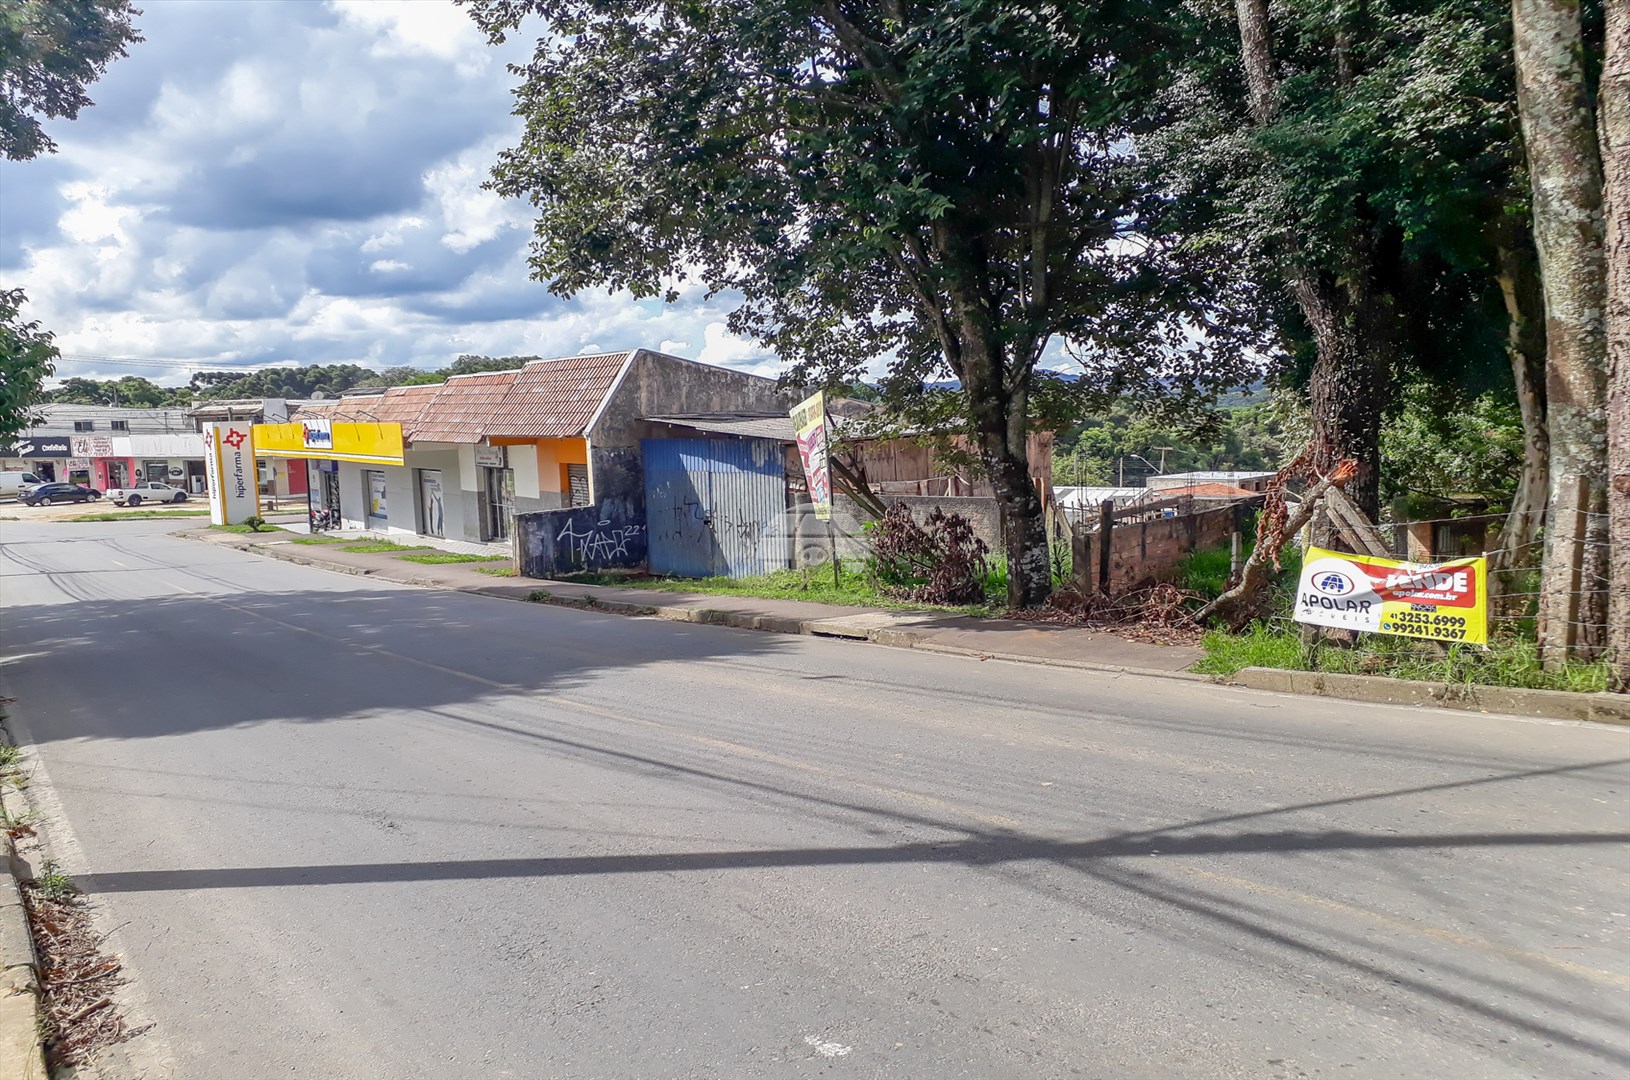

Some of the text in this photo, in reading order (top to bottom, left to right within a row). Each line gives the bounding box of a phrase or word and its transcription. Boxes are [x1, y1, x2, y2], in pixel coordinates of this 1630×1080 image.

[233, 451, 247, 498] hiperfarma
[1301, 592, 1371, 614] APOLAR
[1393, 589, 1458, 601] apolar.com.br
[1399, 612, 1466, 628] 3253.6999
[1392, 623, 1467, 640] 99241.9367
